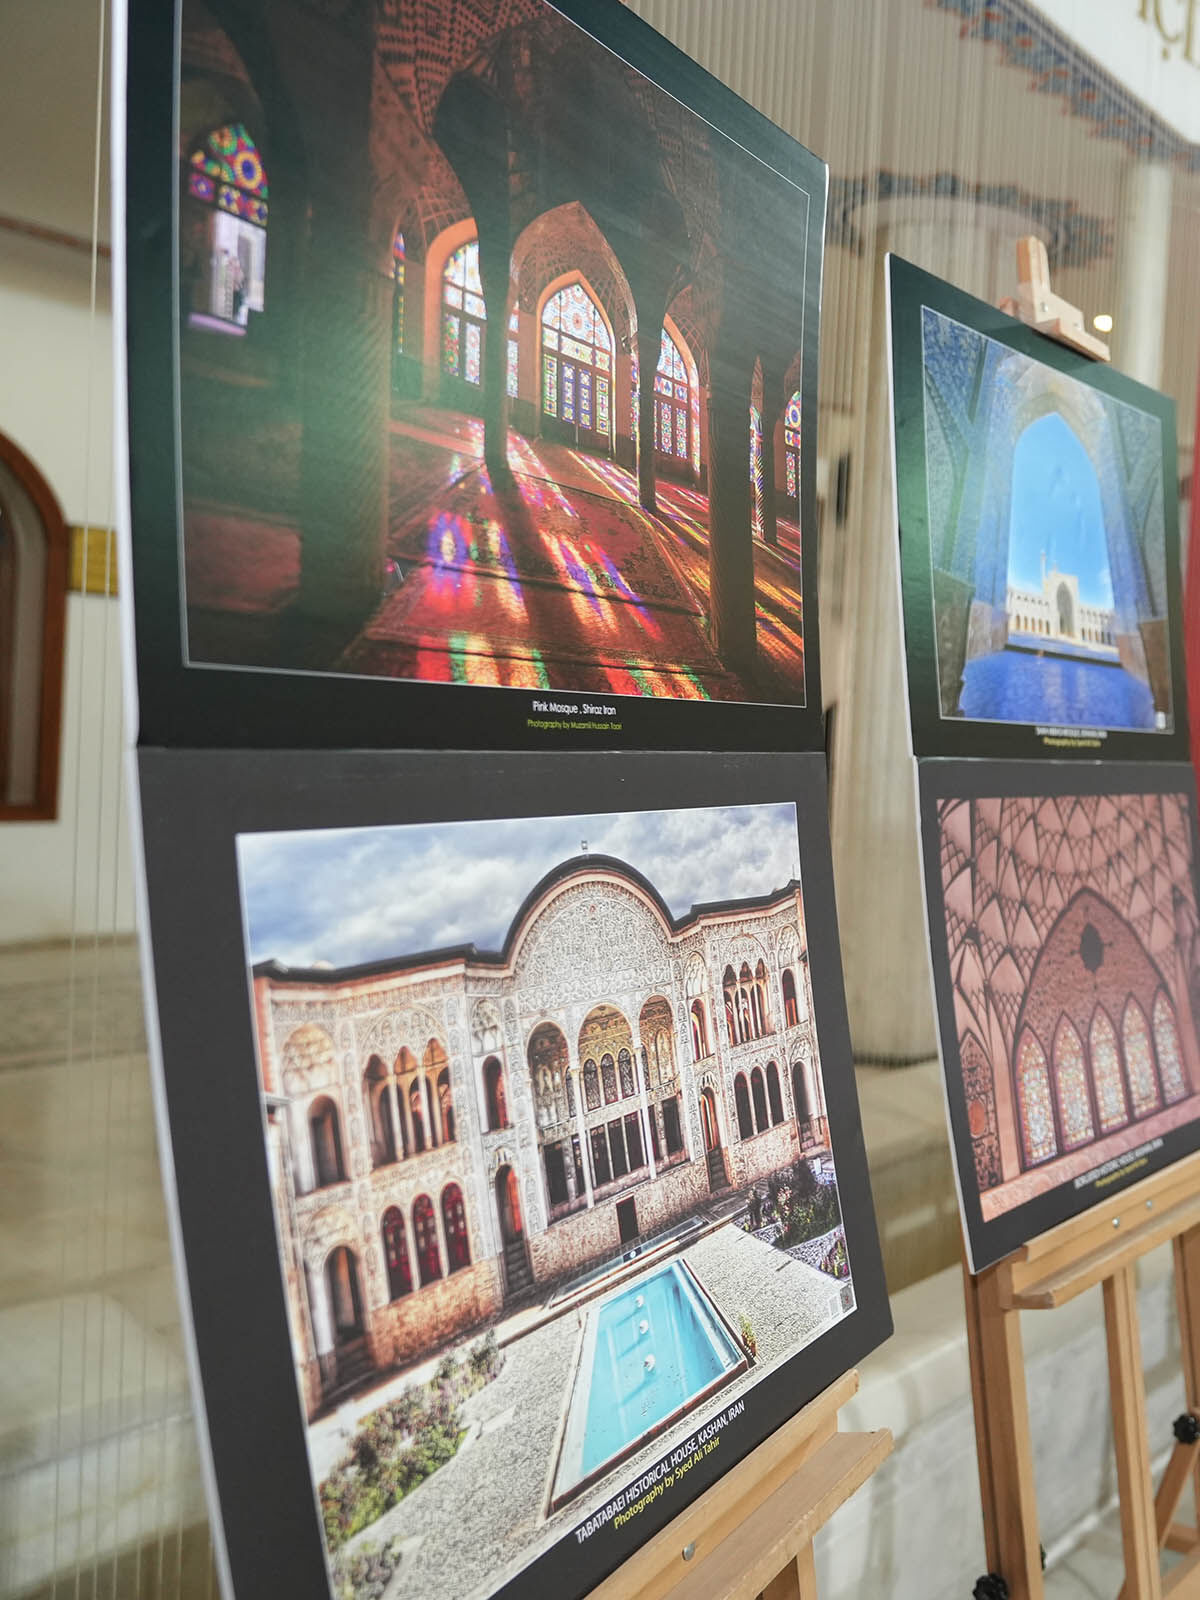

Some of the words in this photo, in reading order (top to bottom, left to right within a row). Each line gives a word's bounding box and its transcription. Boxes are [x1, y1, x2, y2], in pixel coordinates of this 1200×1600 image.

[528, 719, 562, 730] Photography
[562, 720, 570, 730] by
[532, 700, 549, 712] Pink
[549, 702, 579, 716] Mosque
[582, 703, 603, 715] Shiraz
[575, 1495, 627, 1543] TABATABAEI
[626, 1459, 671, 1503] HISTORICAL
[670, 1440, 699, 1468] HOUSE,
[697, 1415, 730, 1446] KASHAN,
[728, 1400, 745, 1422] IRAN
[614, 1483, 664, 1529] Photography
[664, 1474, 675, 1489] by
[675, 1459, 693, 1480] Syed
[694, 1450, 703, 1462] Ali
[702, 1436, 721, 1455] Tahir
